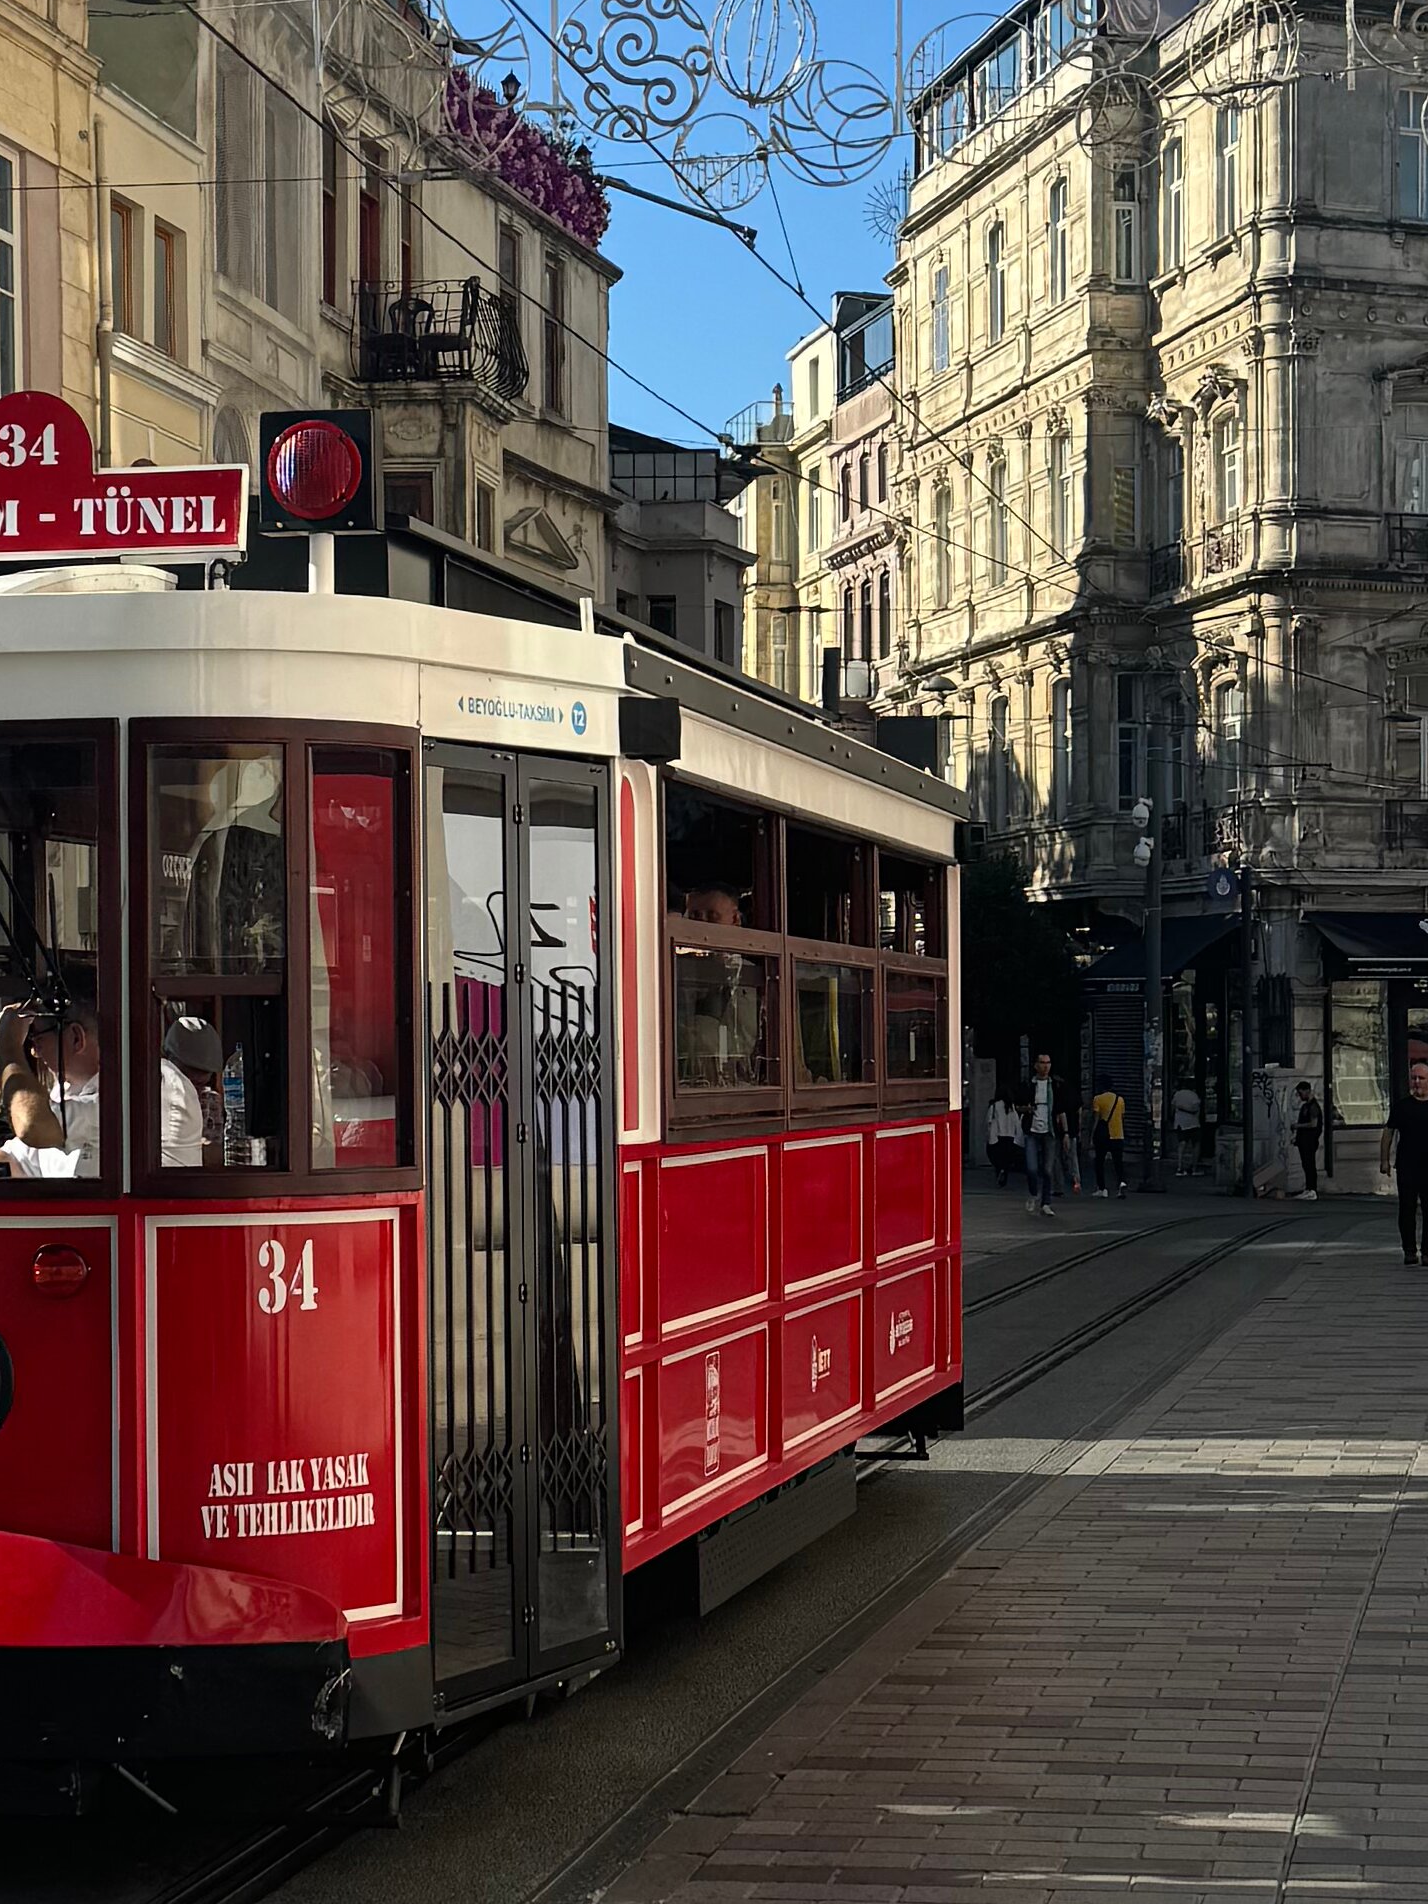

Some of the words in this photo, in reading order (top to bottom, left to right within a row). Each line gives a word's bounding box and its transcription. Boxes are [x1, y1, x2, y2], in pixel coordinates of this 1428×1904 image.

[73, 486, 226, 536] TÜNEL
[258, 1239, 319, 1314] 34
[310, 1452, 370, 1491] YASAK
[200, 1504, 229, 1539] VE
[233, 1493, 375, 1537] TEHLIKELIDIR
